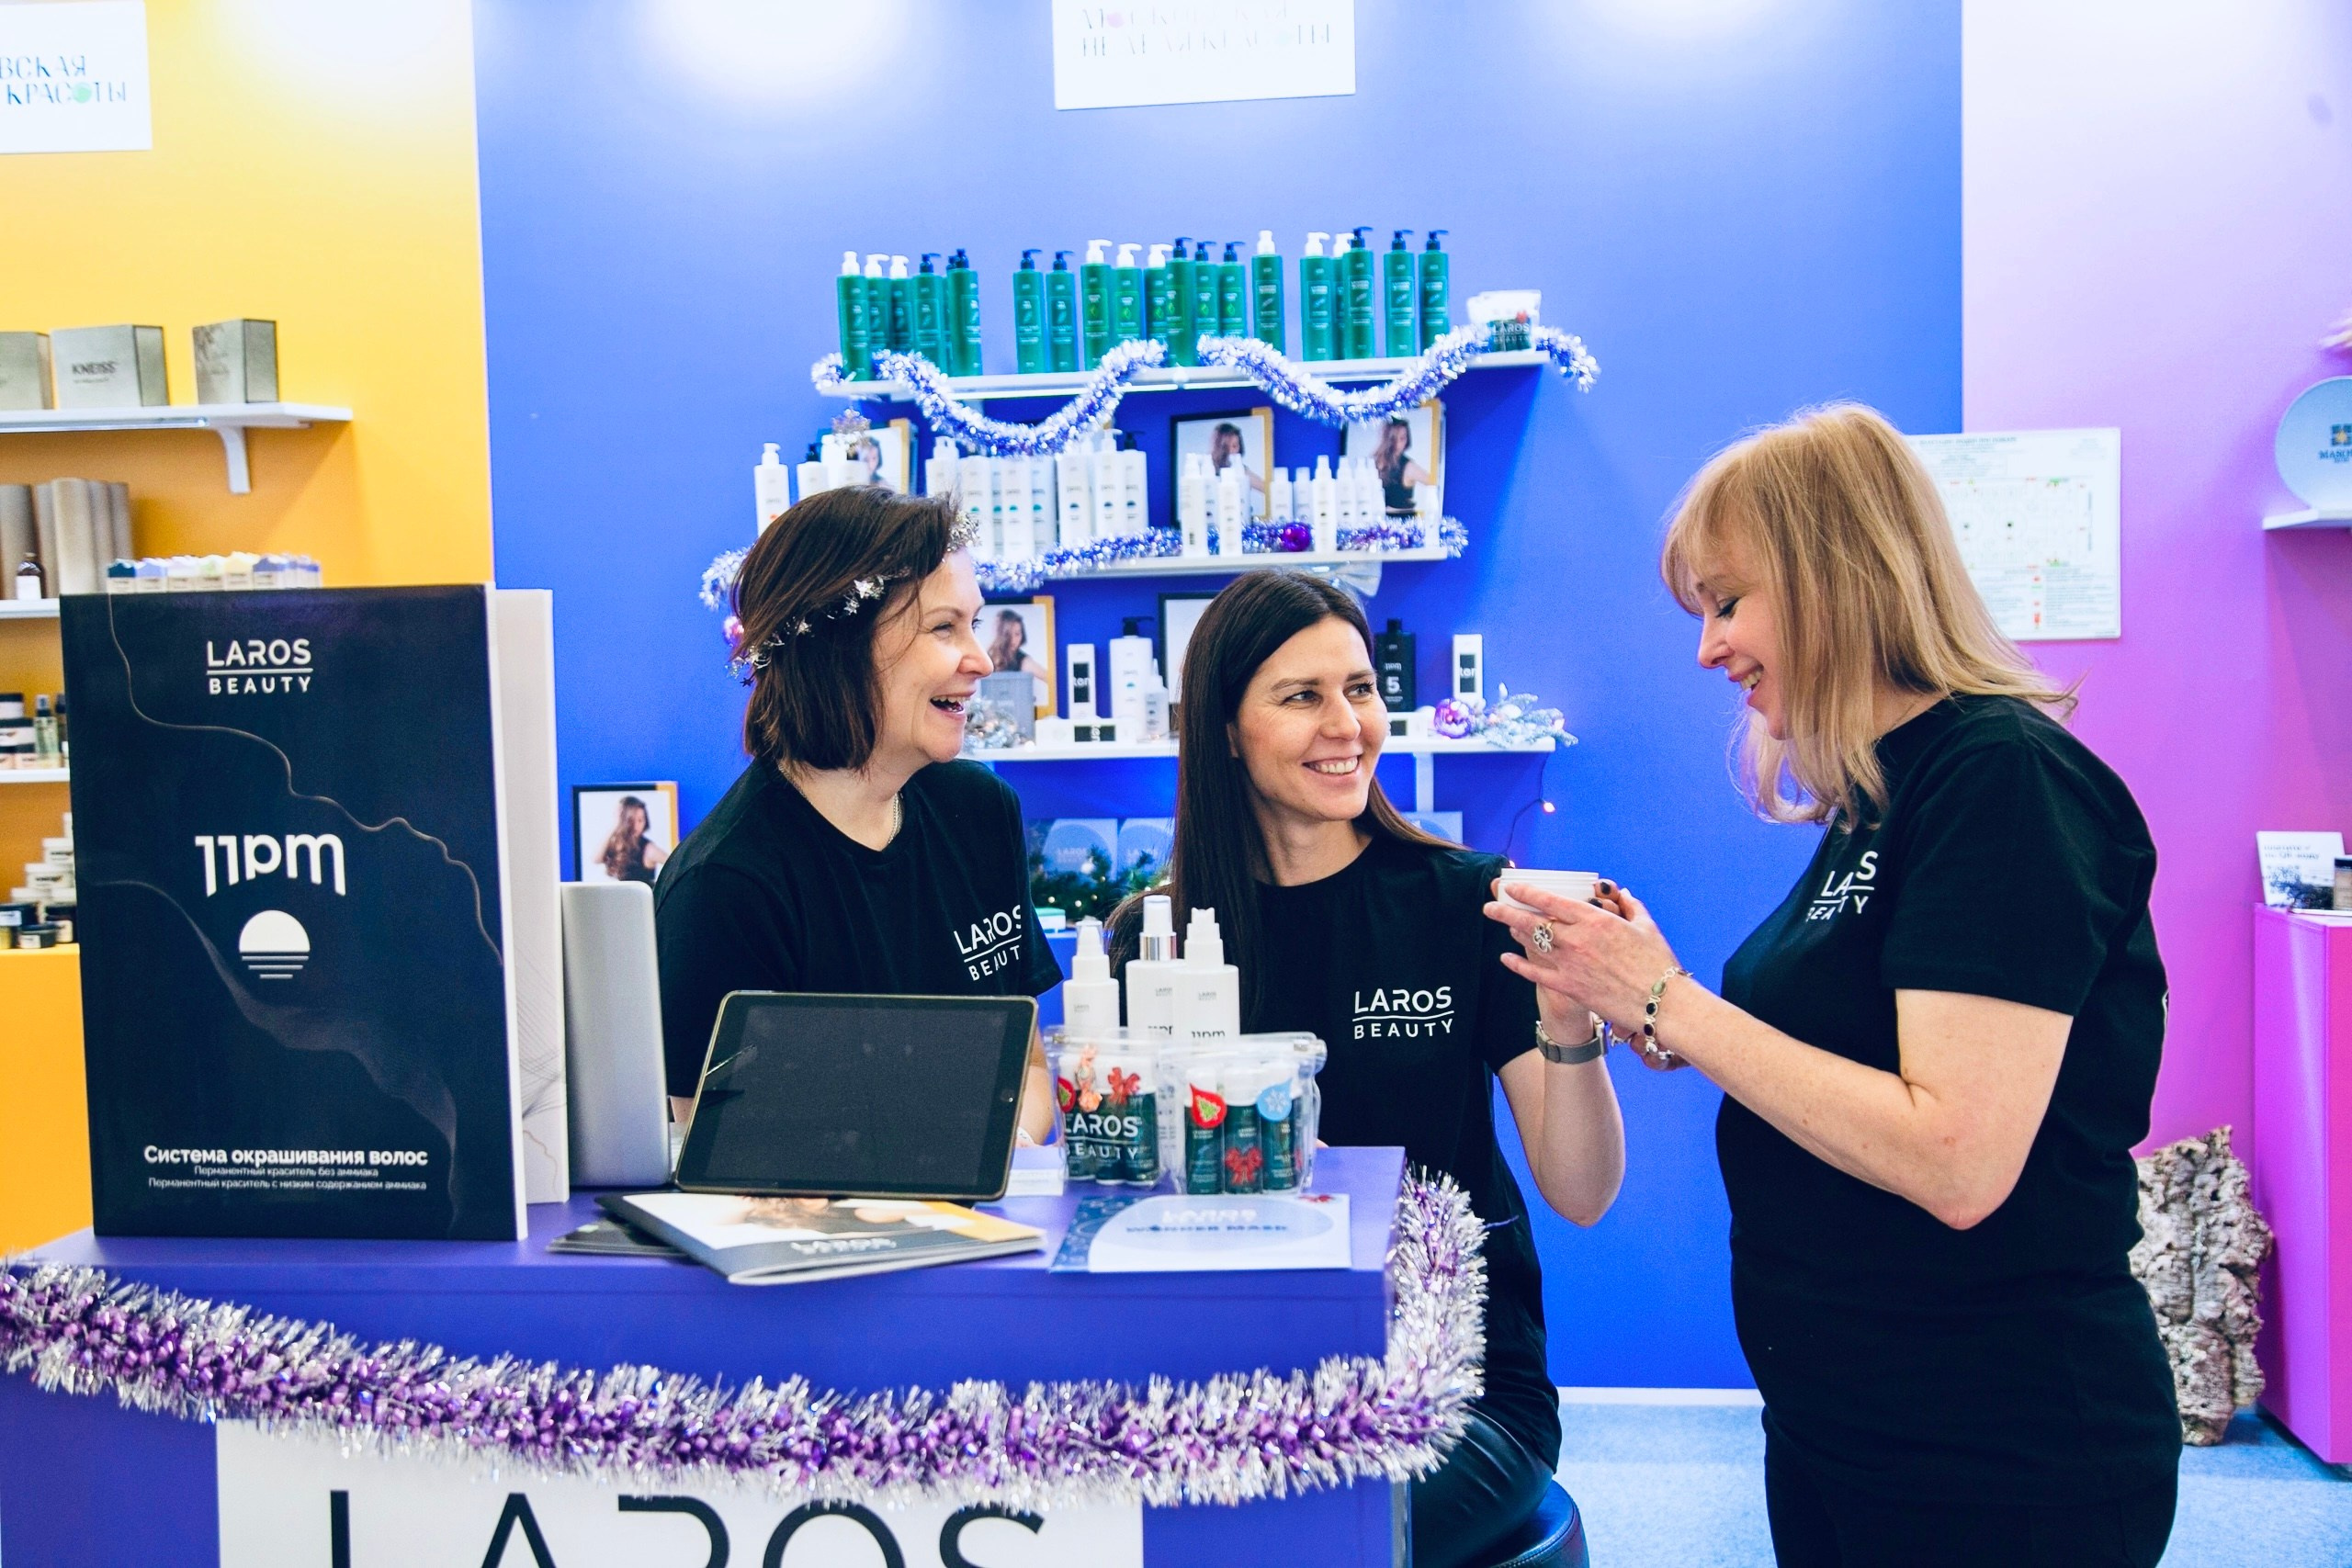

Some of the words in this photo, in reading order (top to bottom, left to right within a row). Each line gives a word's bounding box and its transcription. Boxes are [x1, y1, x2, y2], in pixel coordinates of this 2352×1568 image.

[6, 81, 127, 105] КРАСОТЫ
[207, 638, 311, 667] LAROS
[209, 676, 311, 694] BEAUTY
[195, 833, 346, 897] 11pm
[1821, 851, 1879, 897] LAS
[968, 945, 1020, 981] BEAUT
[1355, 986, 1452, 1013] LAROS
[1354, 1019, 1453, 1040] BEAUTY
[143, 1145, 228, 1165] Система
[232, 1148, 366, 1168] окрашивания
[369, 1150, 428, 1166] волос
[148, 1178, 220, 1189] Перманентный
[221, 1179, 270, 1190] краситель
[279, 1180, 314, 1189] низким
[316, 1179, 383, 1190] содержанием
[385, 1181, 427, 1190] аммиака
[194, 1166, 266, 1177] Перманентный
[267, 1168, 317, 1178] краситель
[318, 1167, 335, 1177] без
[337, 1168, 379, 1177] аммиака
